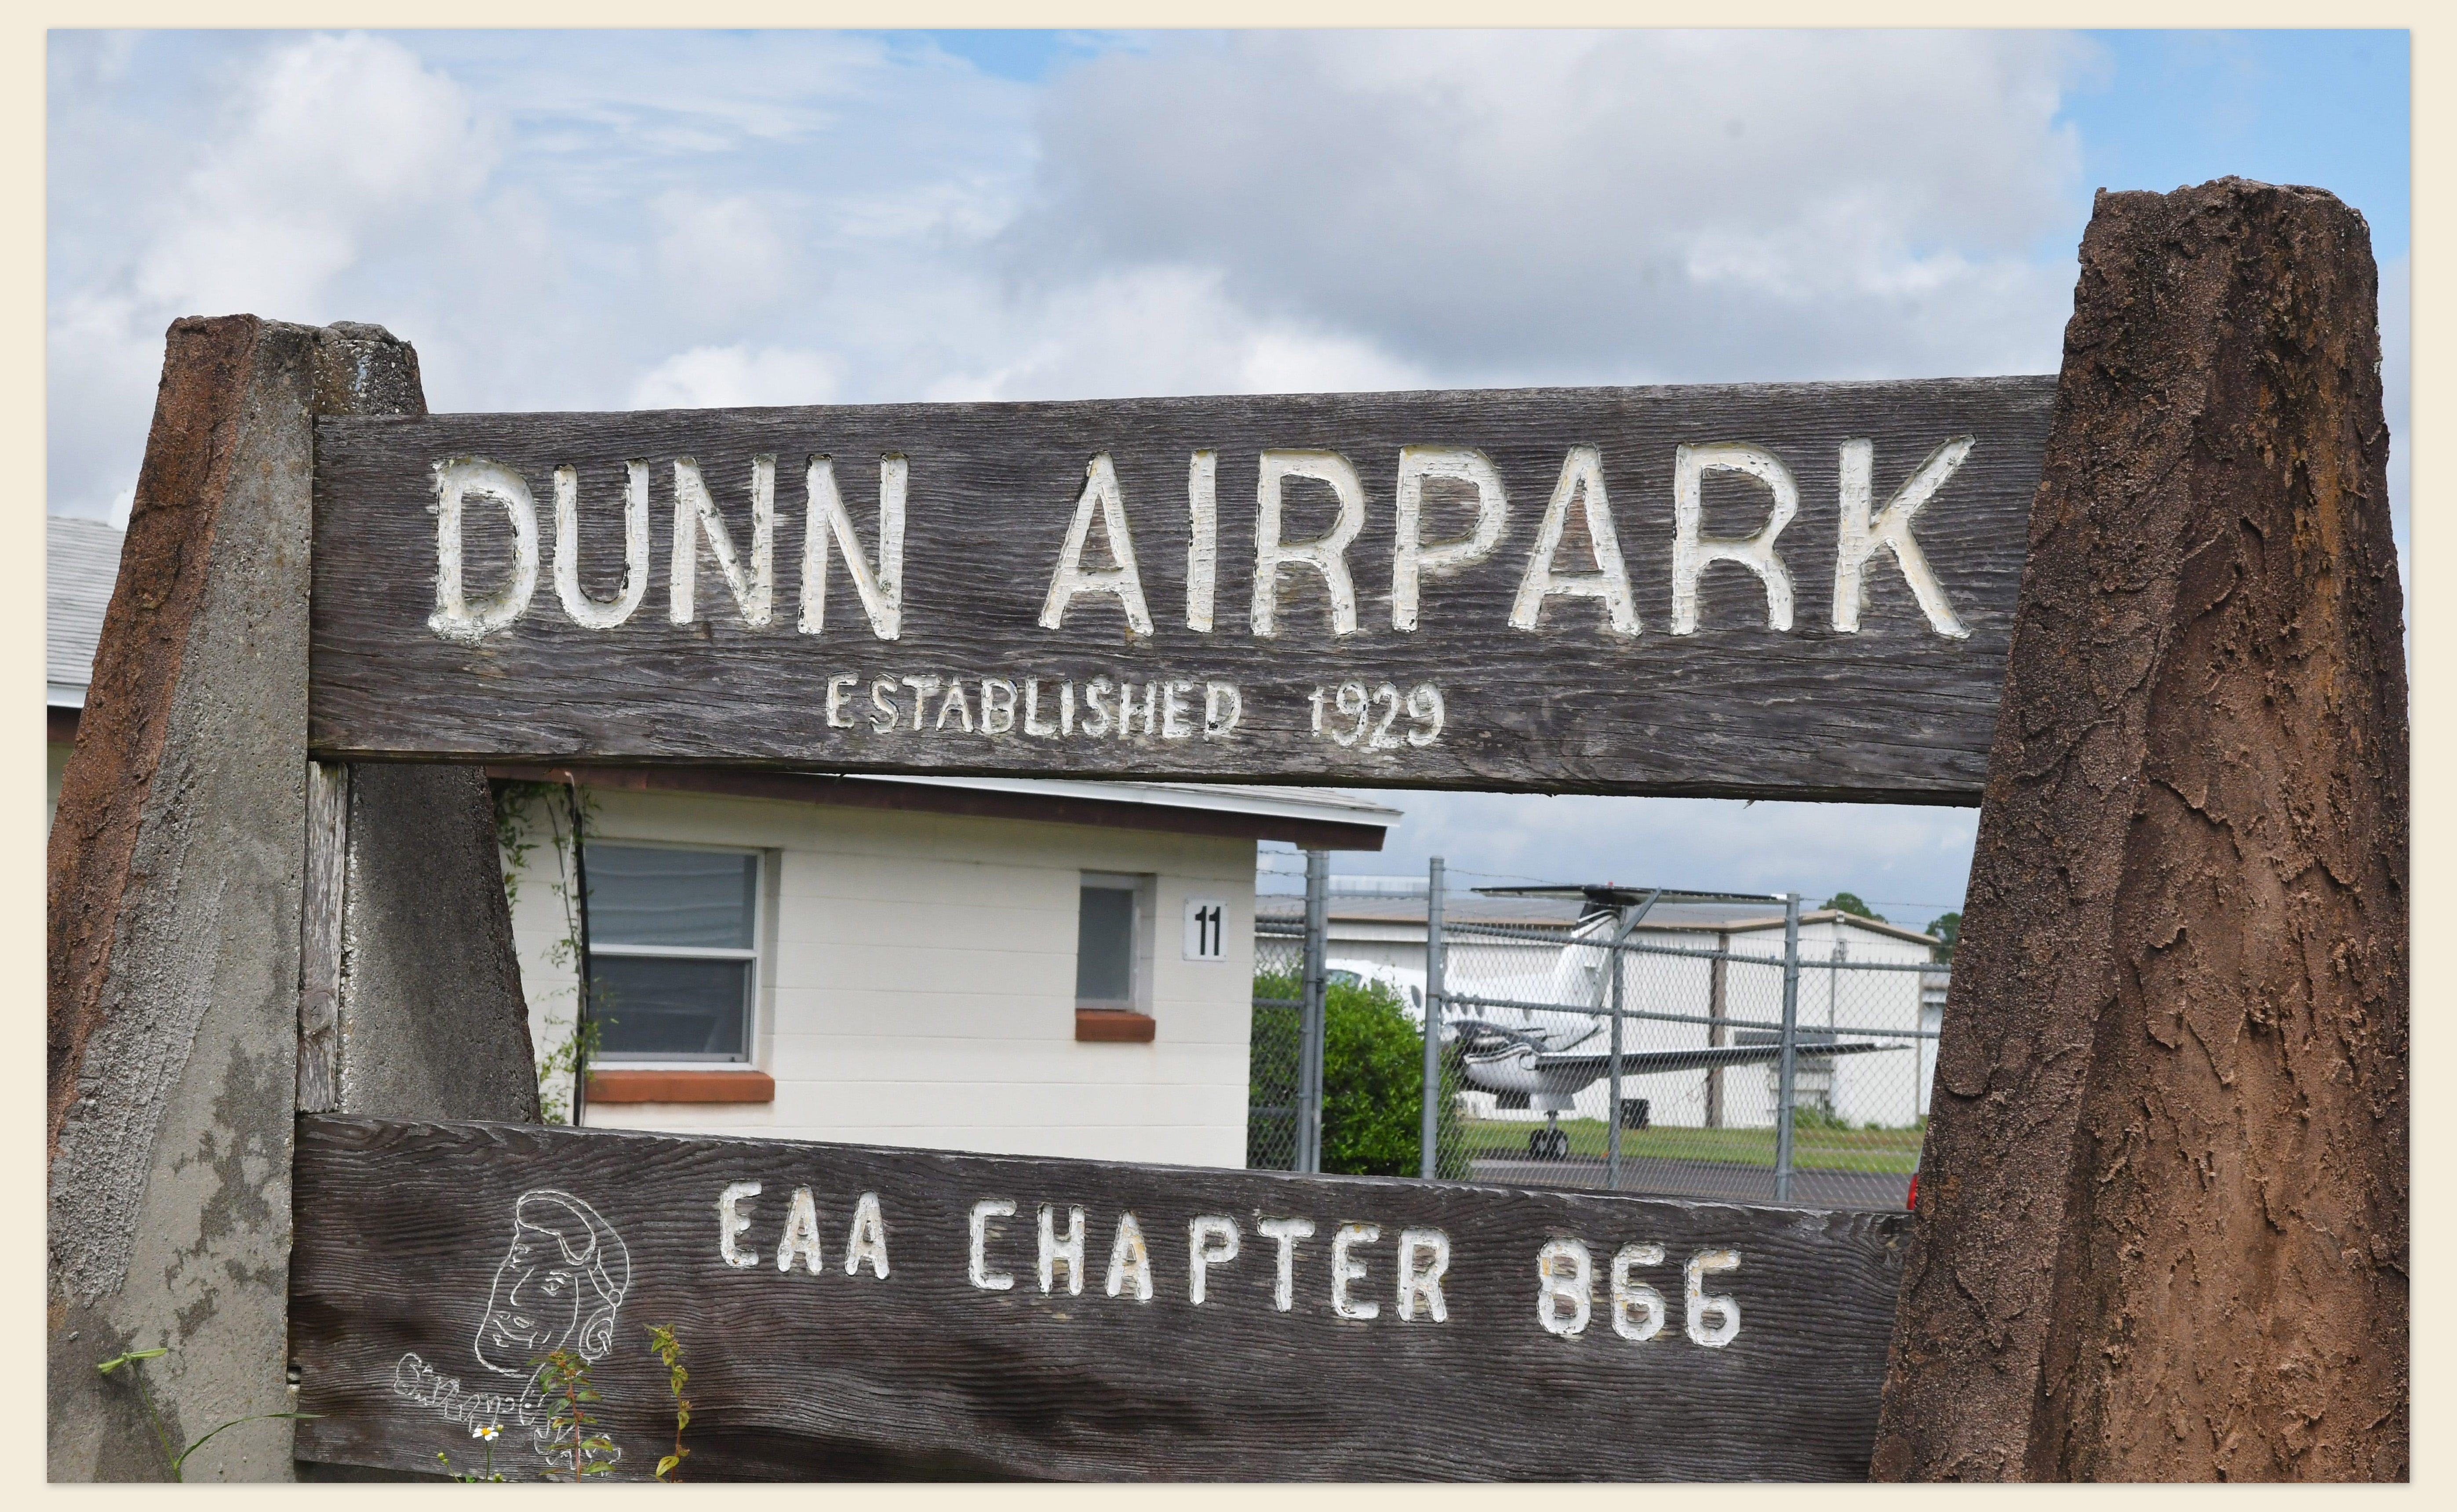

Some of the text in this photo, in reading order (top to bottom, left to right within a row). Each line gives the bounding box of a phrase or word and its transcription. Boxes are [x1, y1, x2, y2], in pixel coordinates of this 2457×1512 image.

[429, 434, 1976, 646] DUNN AIRPARK
[825, 672, 1445, 749] ESTABLISHED 1929
[1195, 905, 1220, 956] 11
[719, 1179, 1742, 1348] EAA CHAPTER 866
